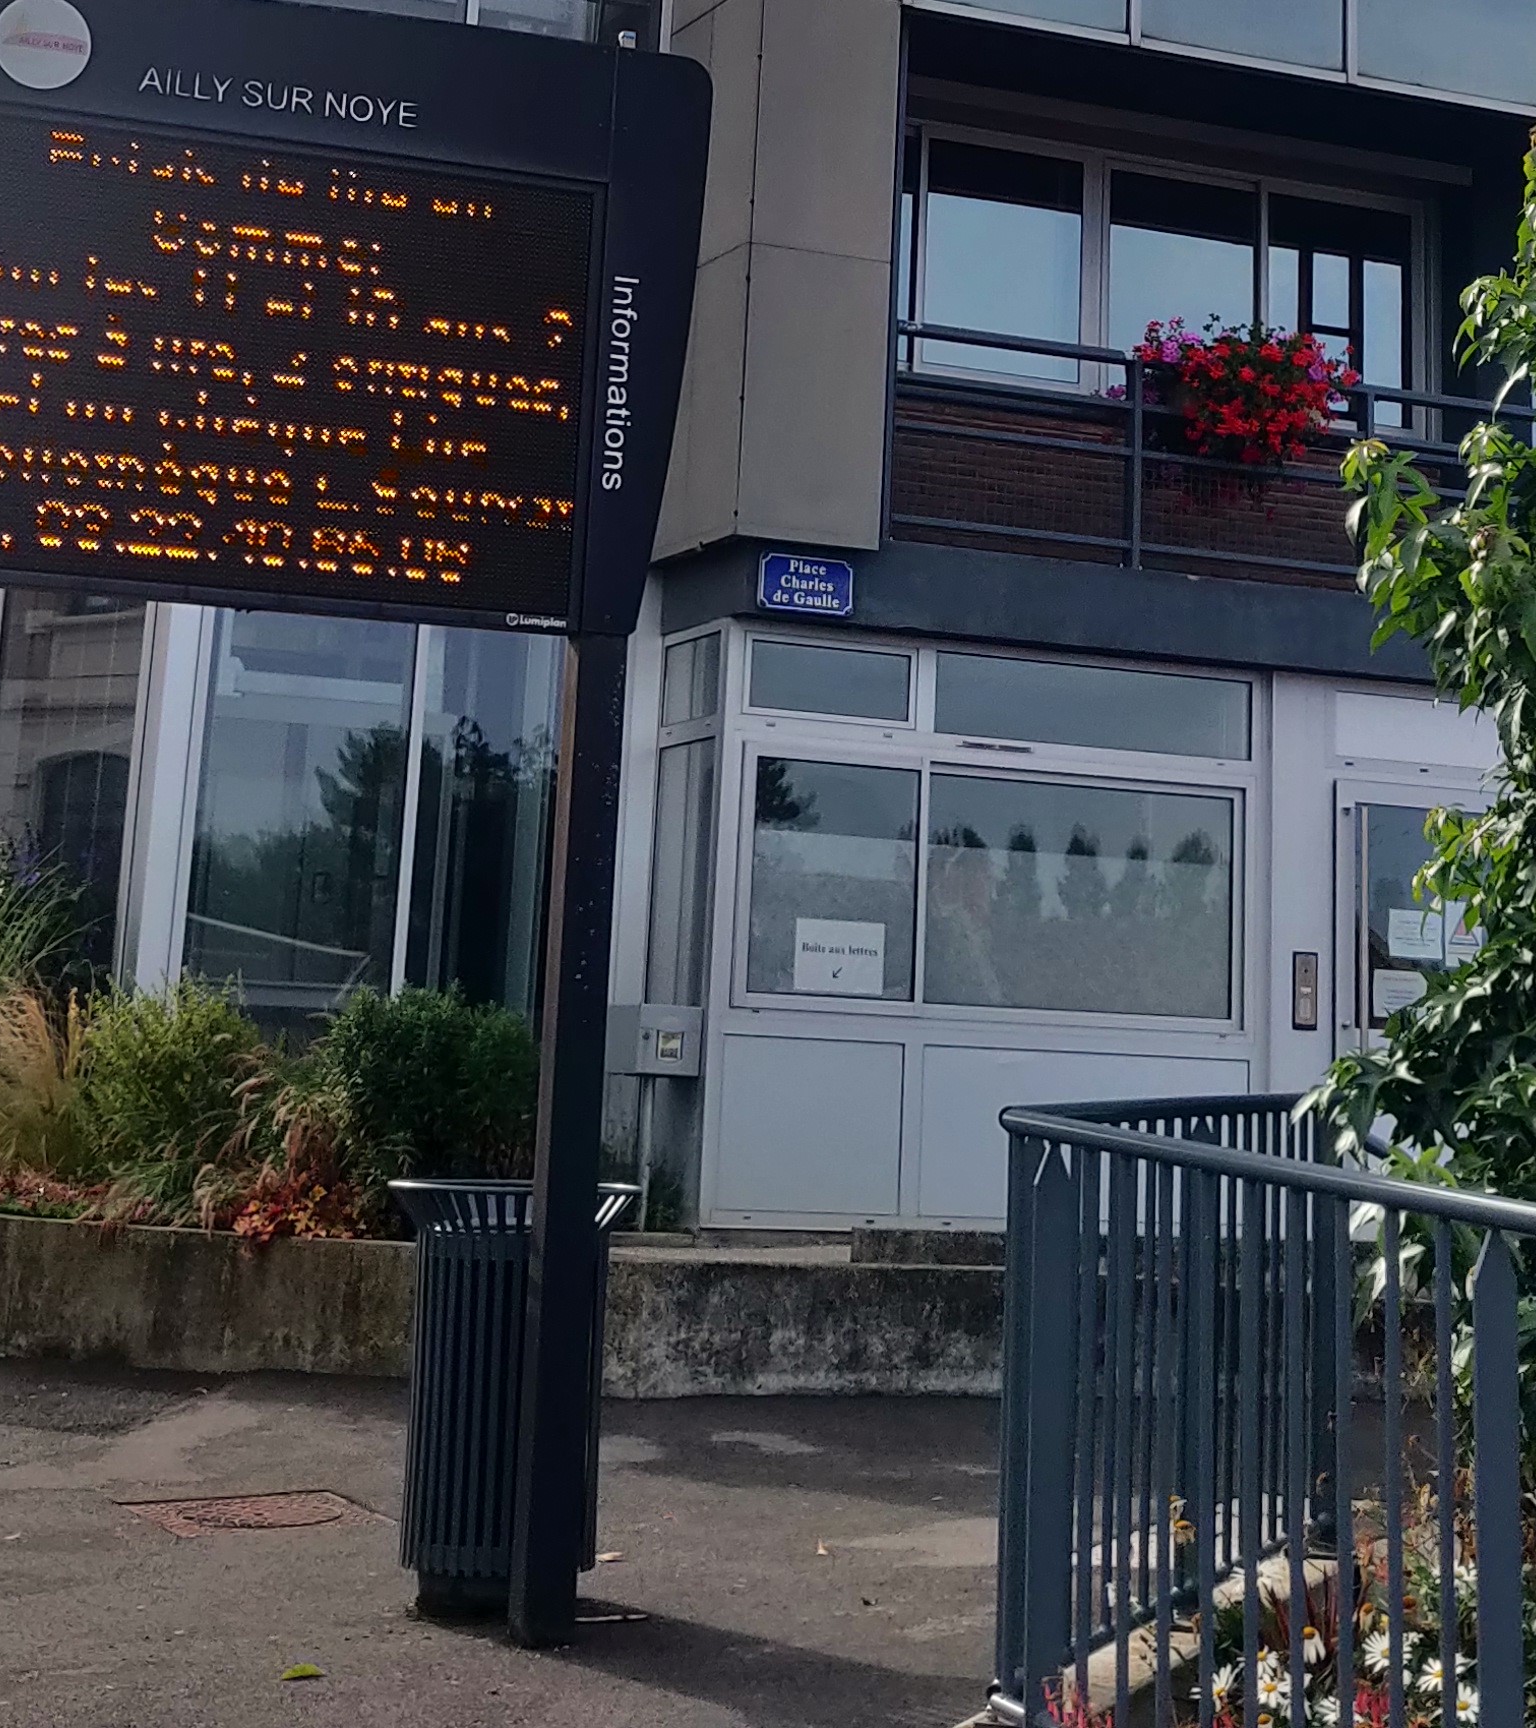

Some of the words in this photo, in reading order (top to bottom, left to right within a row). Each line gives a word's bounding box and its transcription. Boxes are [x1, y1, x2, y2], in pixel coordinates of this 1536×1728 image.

[138, 66, 235, 104] AILLY
[241, 80, 314, 115] SUR
[323, 91, 419, 129] NOYE
[602, 275, 640, 491] Informations
[789, 559, 827, 575] Place
[780, 574, 834, 592] Charles
[772, 589, 789, 603] de
[793, 591, 840, 608] Gaulle
[519, 614, 567, 628] Lumiplan
[848, 945, 878, 957] lettres
